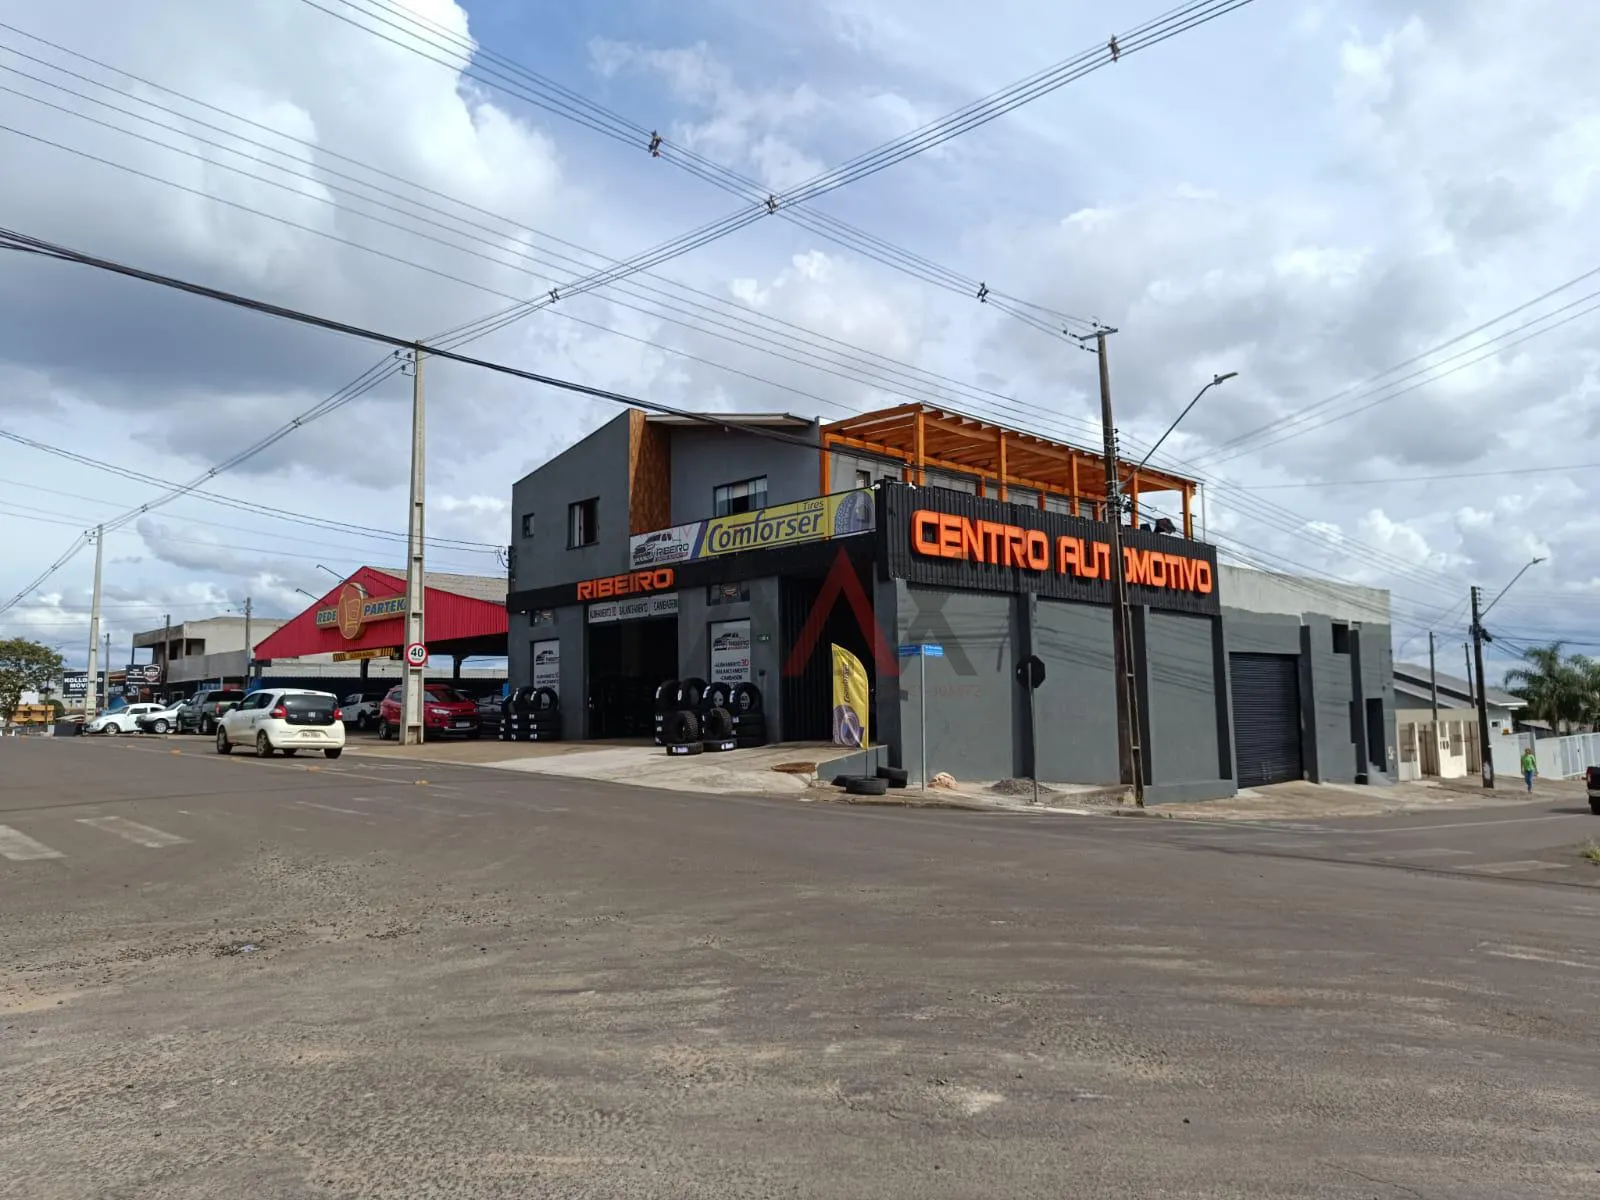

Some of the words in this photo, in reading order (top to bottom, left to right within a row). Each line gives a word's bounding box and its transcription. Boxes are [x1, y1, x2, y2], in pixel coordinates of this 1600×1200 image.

[802, 500, 824, 511] Tires
[707, 509, 824, 553] Comforser
[657, 543, 690, 556] RIBEIRO
[911, 510, 1049, 571] CENTRO
[1057, 536, 1212, 594] AUTOMOTIVO
[577, 568, 674, 600] RIBEIRO
[317, 609, 337, 624] REDE
[364, 597, 407, 616] PARTEK
[411, 648, 424, 657] 40
